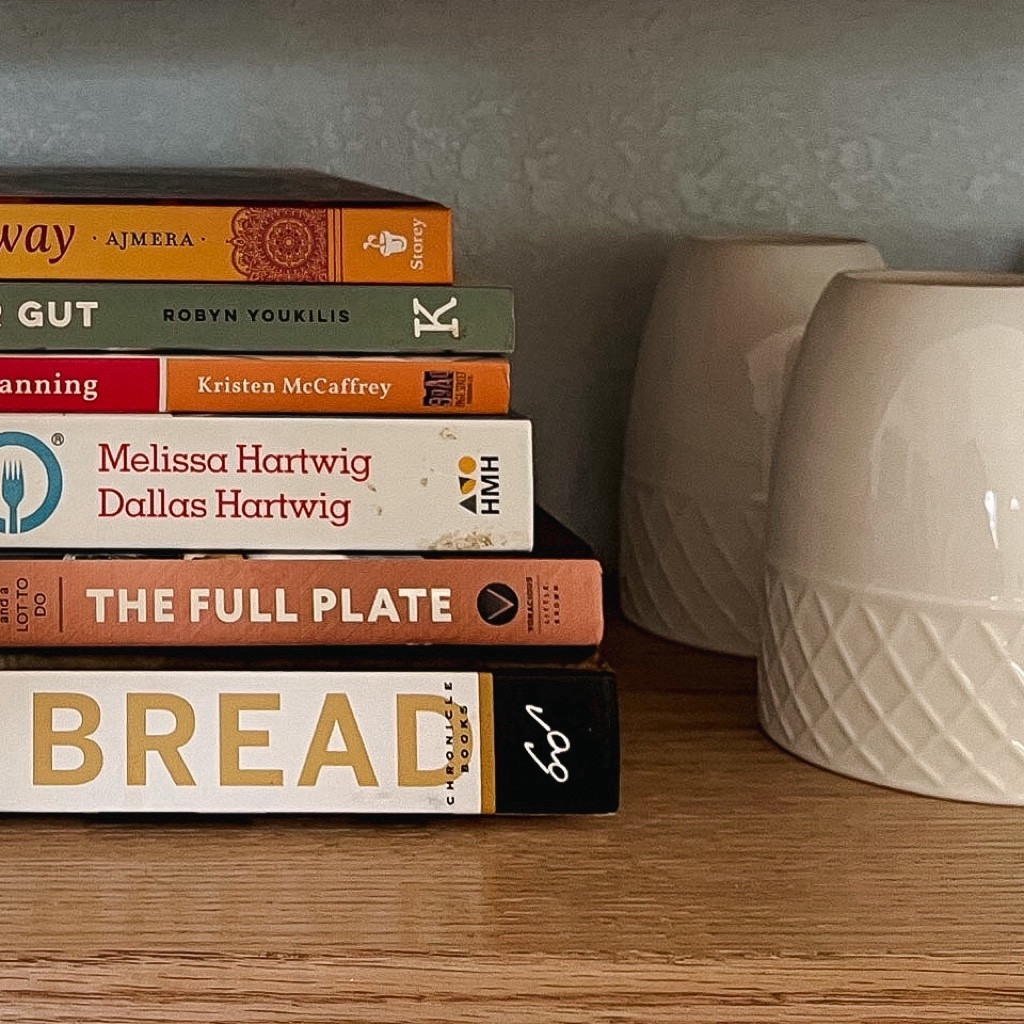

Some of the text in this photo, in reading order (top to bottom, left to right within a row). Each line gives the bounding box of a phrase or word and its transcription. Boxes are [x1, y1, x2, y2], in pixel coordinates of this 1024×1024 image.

[105, 231, 195, 250] AJMERA
[410, 217, 427, 271] Storey
[17, 301, 99, 327] GUT
[163, 309, 351, 323] ROBYN YOUKILIS
[412, 296, 459, 338] K
[197, 376, 392, 399] Kristen McCaffrey
[97, 443, 372, 482] Melissa Hartwig
[480, 455, 500, 515] HMH
[97, 488, 351, 527] Dallas Hartwig
[16, 577, 28, 632] LOT TO
[34, 592, 46, 617] DO
[86, 588, 452, 623] THE FULL PLATE
[32, 692, 473, 787] BREAD
[444, 682, 455, 805] CHRONICLE
[460, 705, 469, 773] BOOKS
